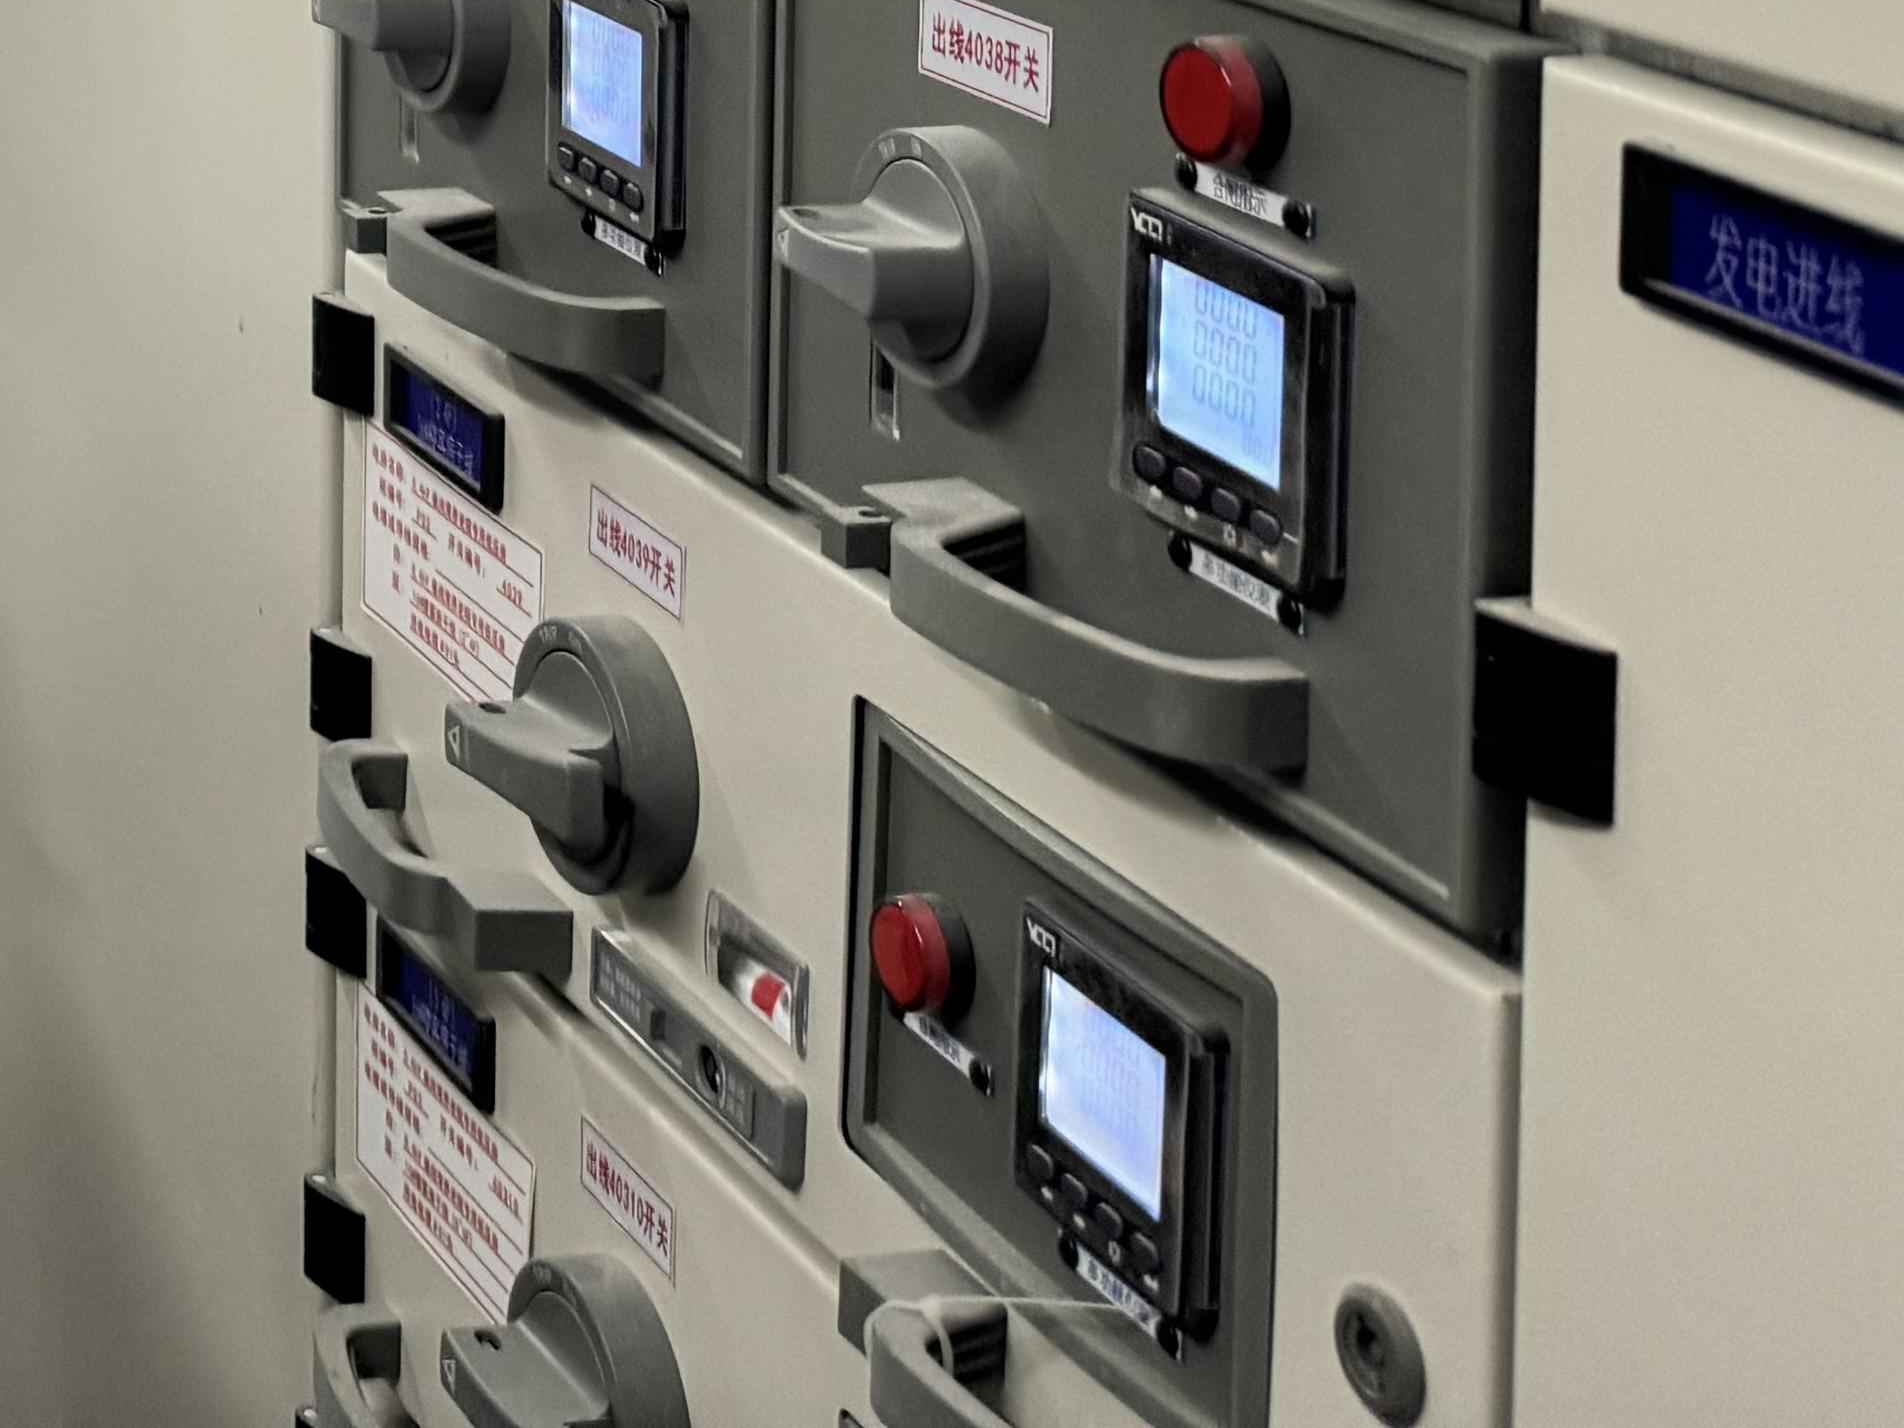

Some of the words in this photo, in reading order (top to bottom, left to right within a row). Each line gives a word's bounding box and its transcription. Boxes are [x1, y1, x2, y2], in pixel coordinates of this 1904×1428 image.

[931, 11, 1040, 93] 出线4038开关
[1704, 215, 1864, 355] 发电进线
[596, 509, 677, 598] 出线4039开关
[586, 1143, 669, 1258] 出线40310开关
